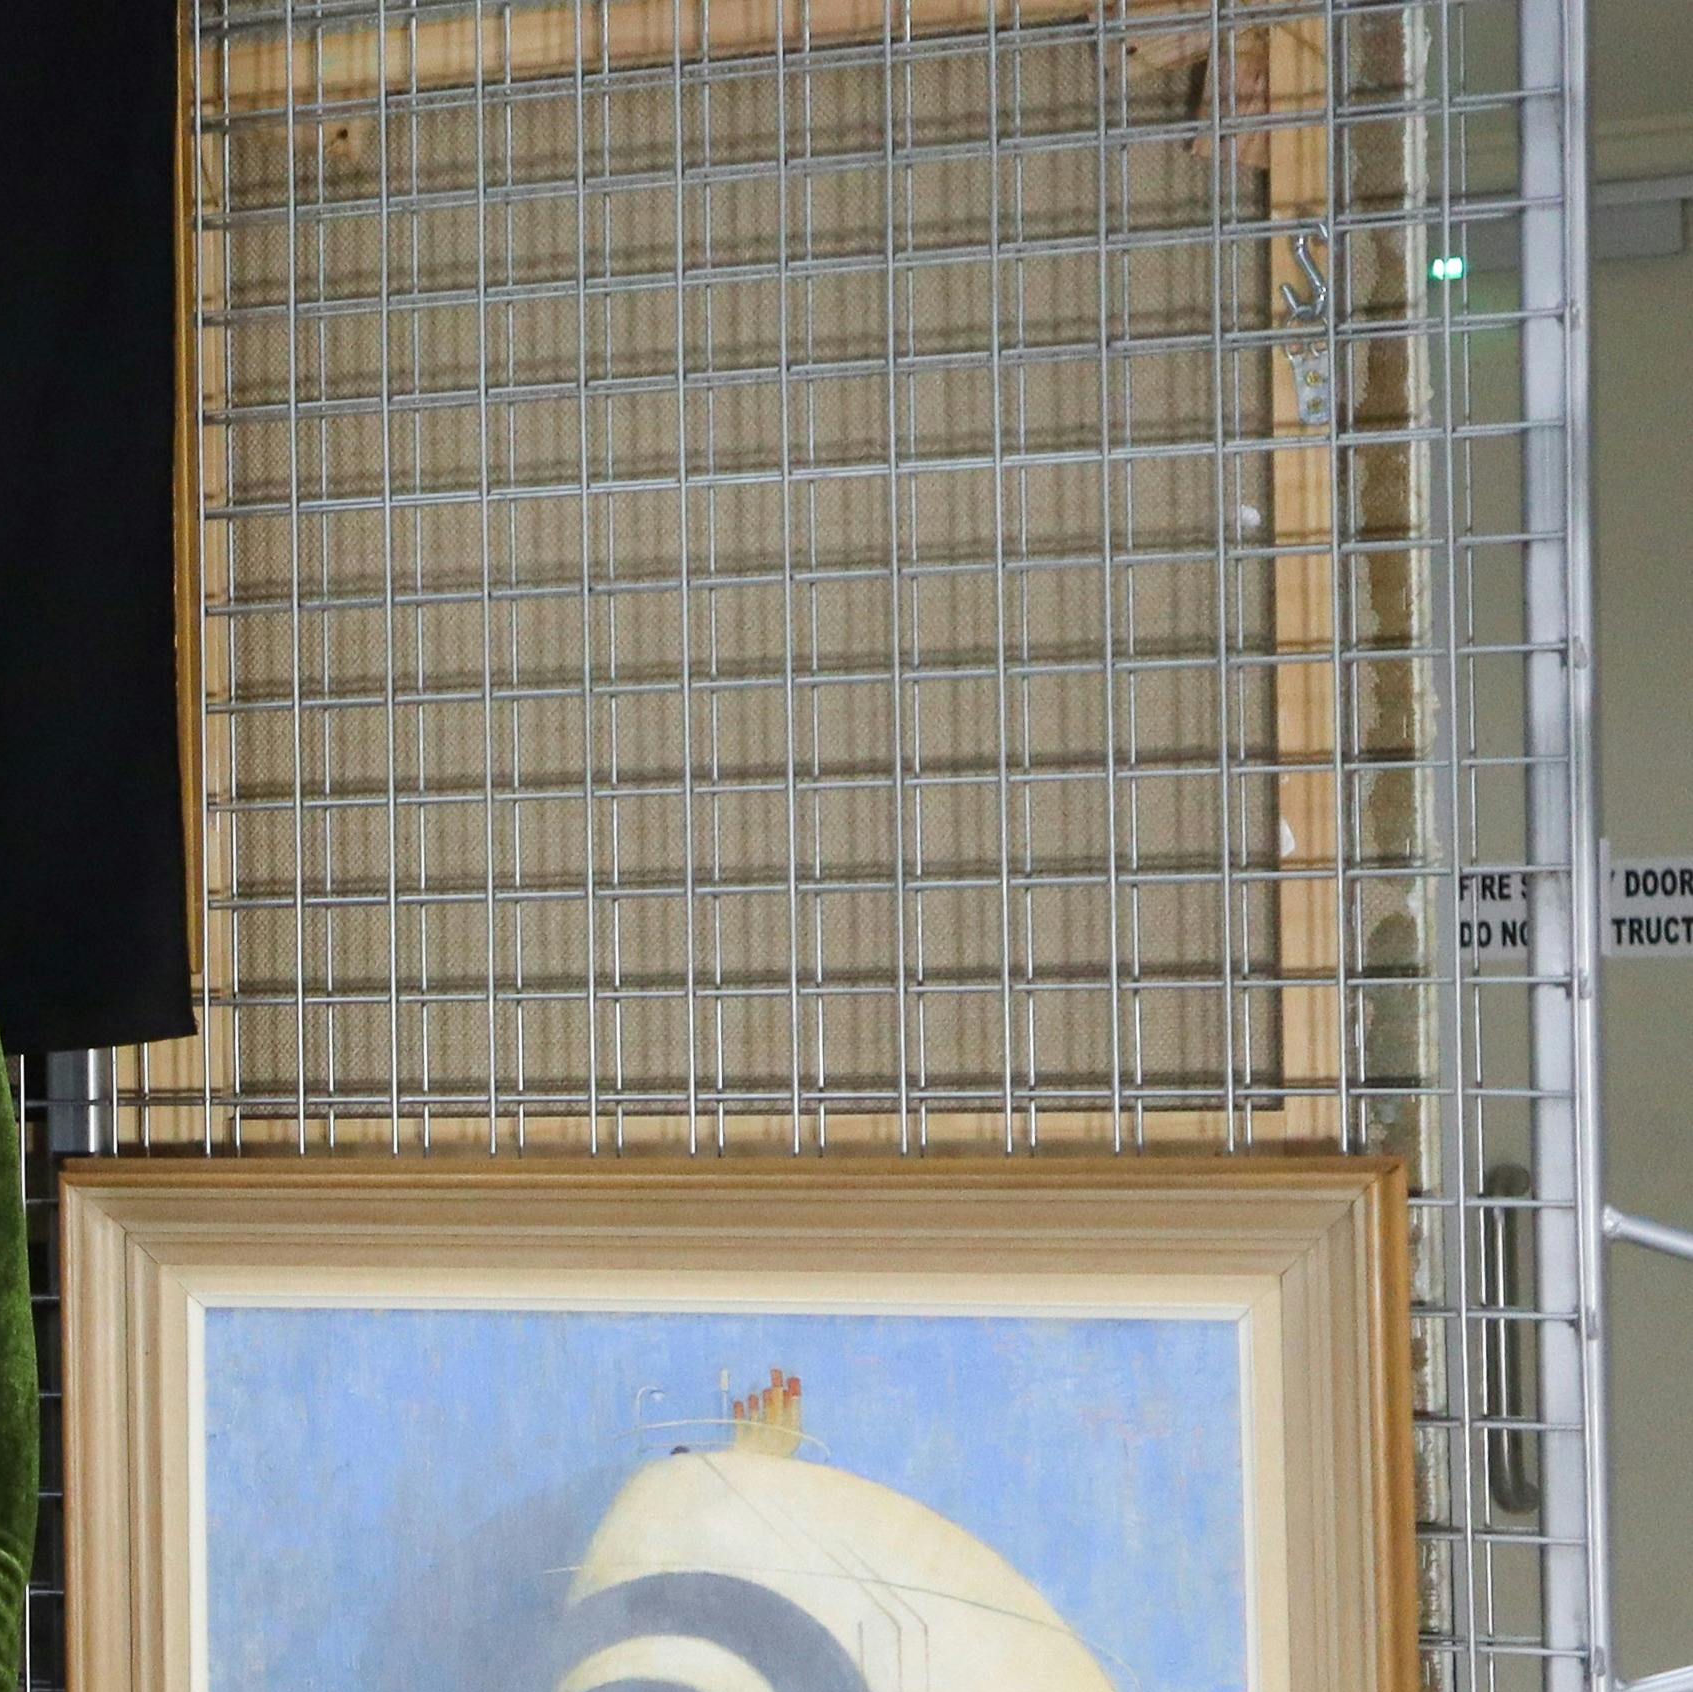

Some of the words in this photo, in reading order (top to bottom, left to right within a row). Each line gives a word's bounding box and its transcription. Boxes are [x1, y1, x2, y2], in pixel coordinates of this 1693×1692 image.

[1625, 867, 1693, 898] DOOR
[1460, 921, 1492, 948] DO
[1501, 919, 1529, 948] NO
[1611, 916, 1693, 945] TRUCT
